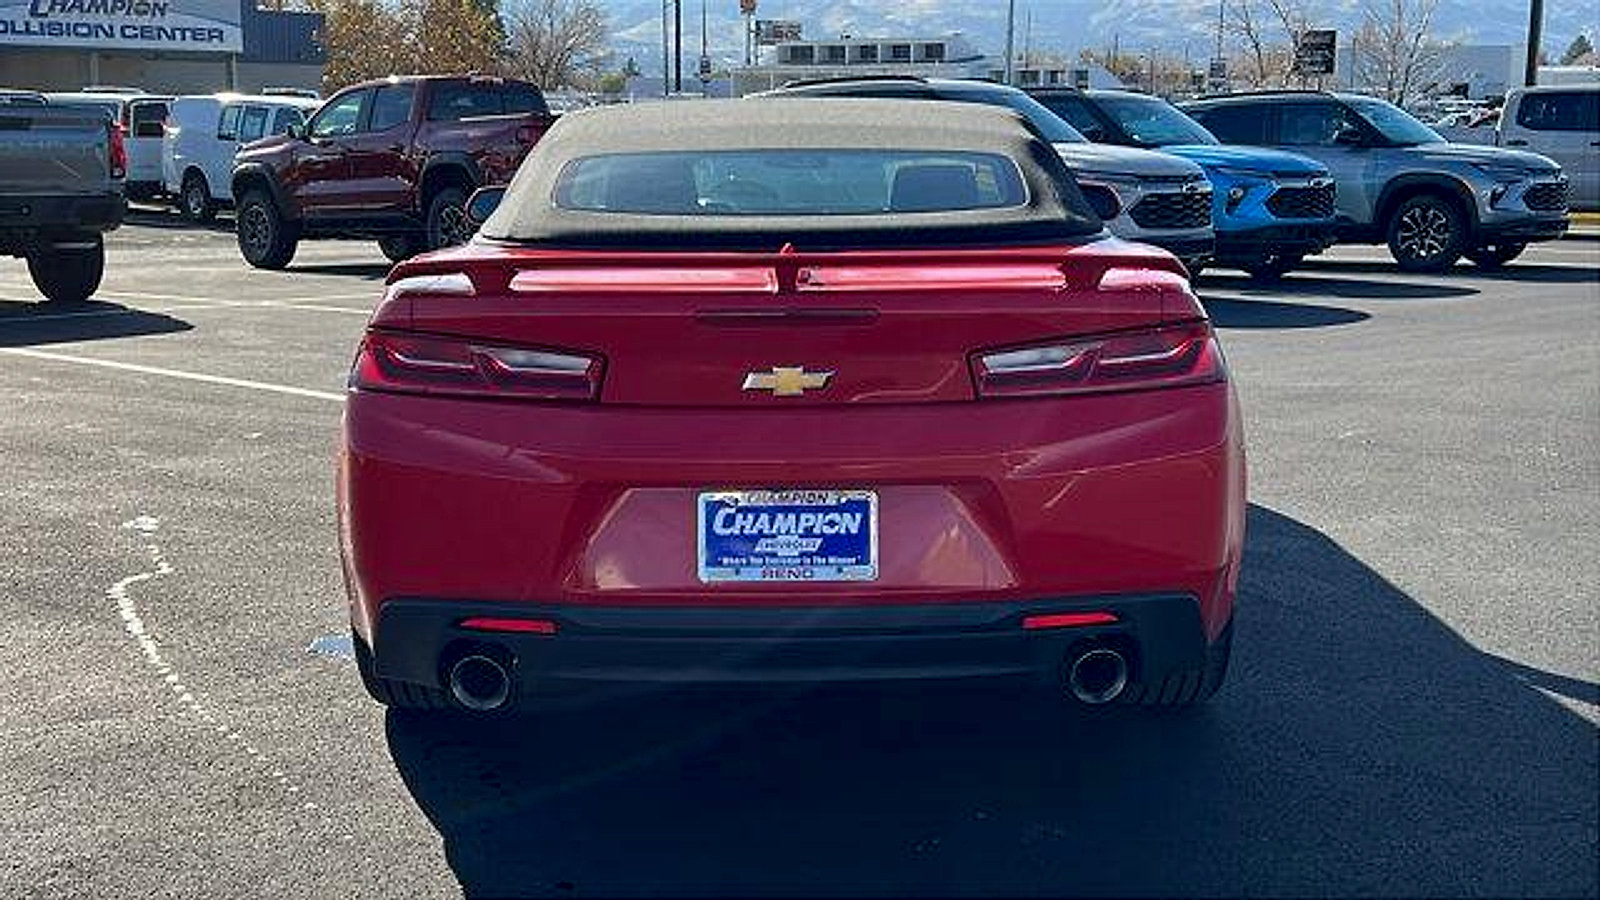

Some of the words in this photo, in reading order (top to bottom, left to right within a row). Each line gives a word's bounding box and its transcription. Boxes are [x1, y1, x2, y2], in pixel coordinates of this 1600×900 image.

[29, 0, 168, 17] CHAMPION
[120, 25, 225, 43] CENTER
[712, 508, 862, 536] CHAMPION
[762, 567, 814, 578] RENO
